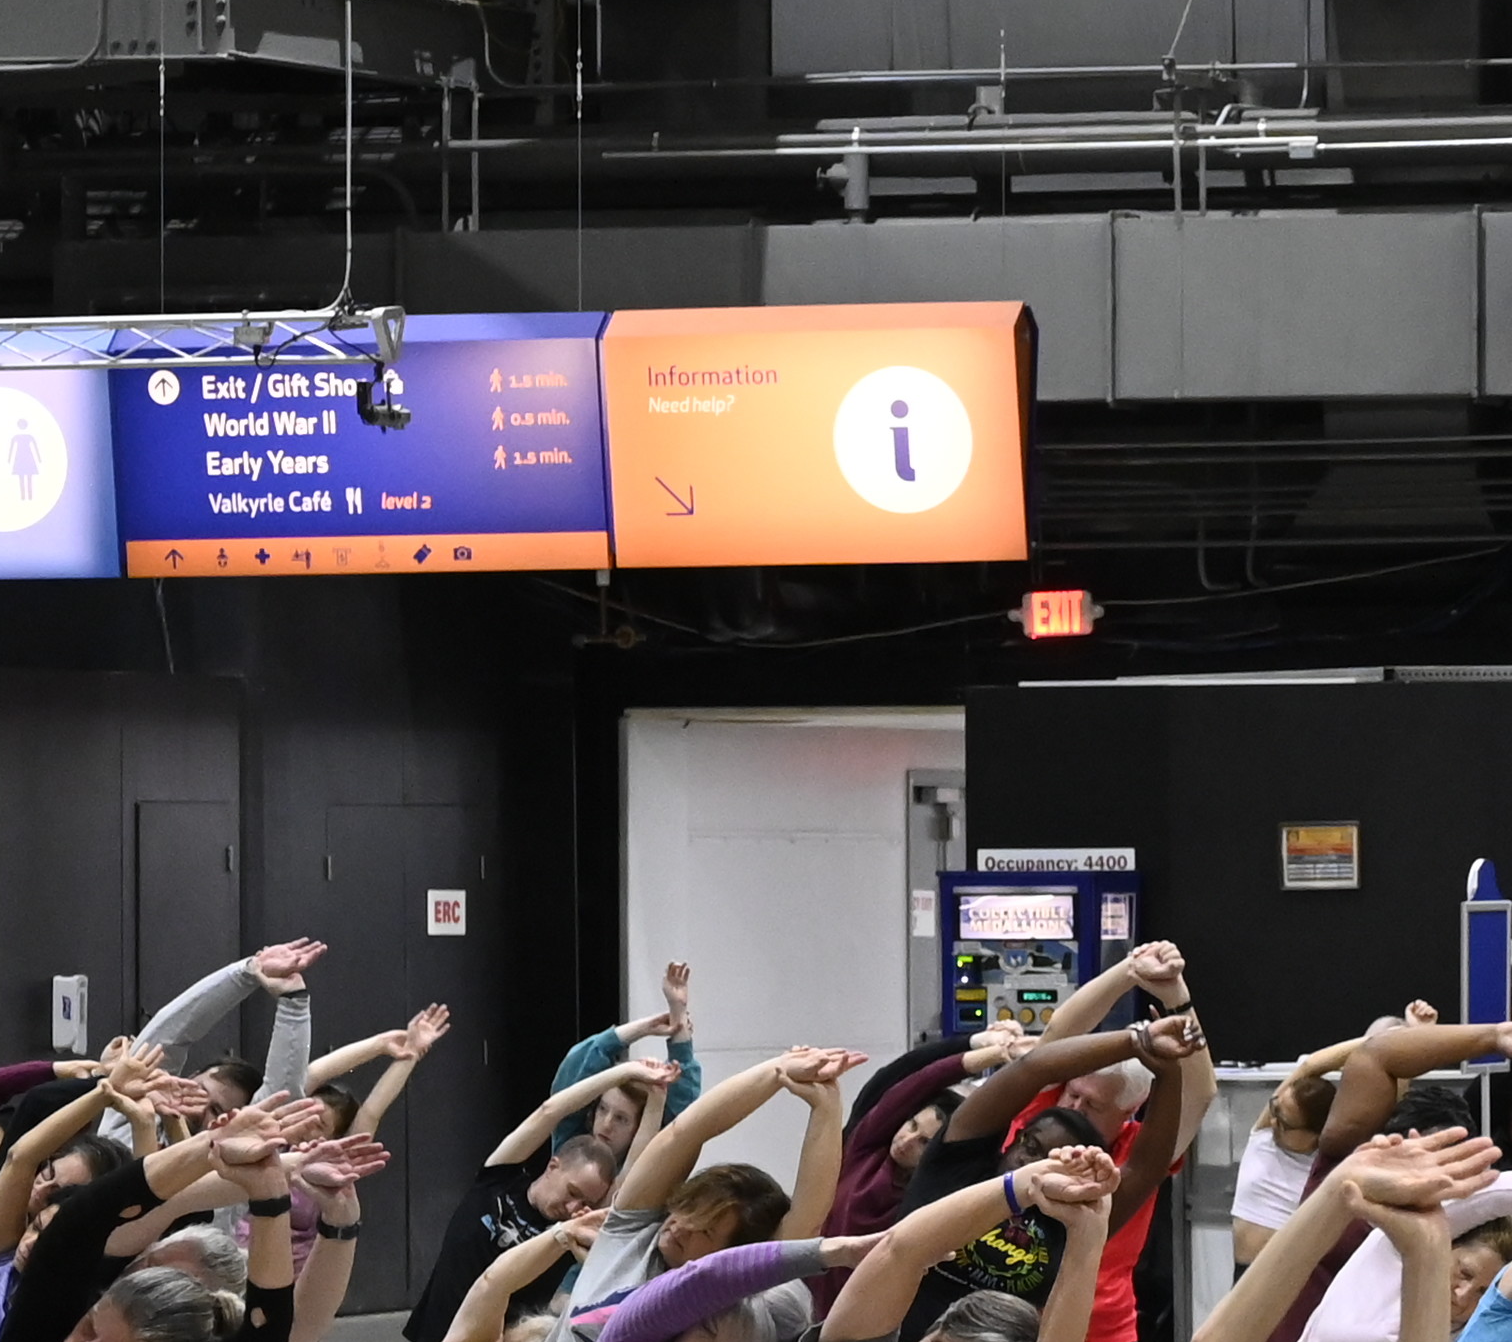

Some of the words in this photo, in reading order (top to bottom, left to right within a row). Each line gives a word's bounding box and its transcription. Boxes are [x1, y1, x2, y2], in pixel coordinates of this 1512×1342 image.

[202, 373, 247, 400] Exit
[250, 373, 263, 403] /
[267, 372, 312, 398] Gift
[314, 372, 367, 397] Sho
[509, 375, 533, 388] 1.5
[535, 372, 568, 388] min.
[647, 365, 778, 388] Information
[648, 396, 690, 414] Need
[692, 395, 736, 417] help?
[204, 411, 269, 438] World
[273, 411, 316, 435] War
[322, 410, 337, 434] II
[511, 413, 535, 426] 0.5
[537, 410, 570, 425] min.
[206, 451, 262, 481] Early
[266, 450, 329, 475] Years
[513, 451, 537, 465] 1.5
[540, 448, 573, 465] min.
[209, 492, 285, 519] Valkyrie
[288, 490, 332, 513] Café
[381, 491, 417, 510] level
[420, 497, 432, 509] 2
[1032, 590, 1084, 636] EXIT
[984, 855, 1079, 871] Occupancy:
[1083, 854, 1128, 871] 4400
[434, 900, 461, 923] ERC
[968, 906, 1067, 920] COLLECTIBLE
[979, 1227, 1038, 1266] hange
